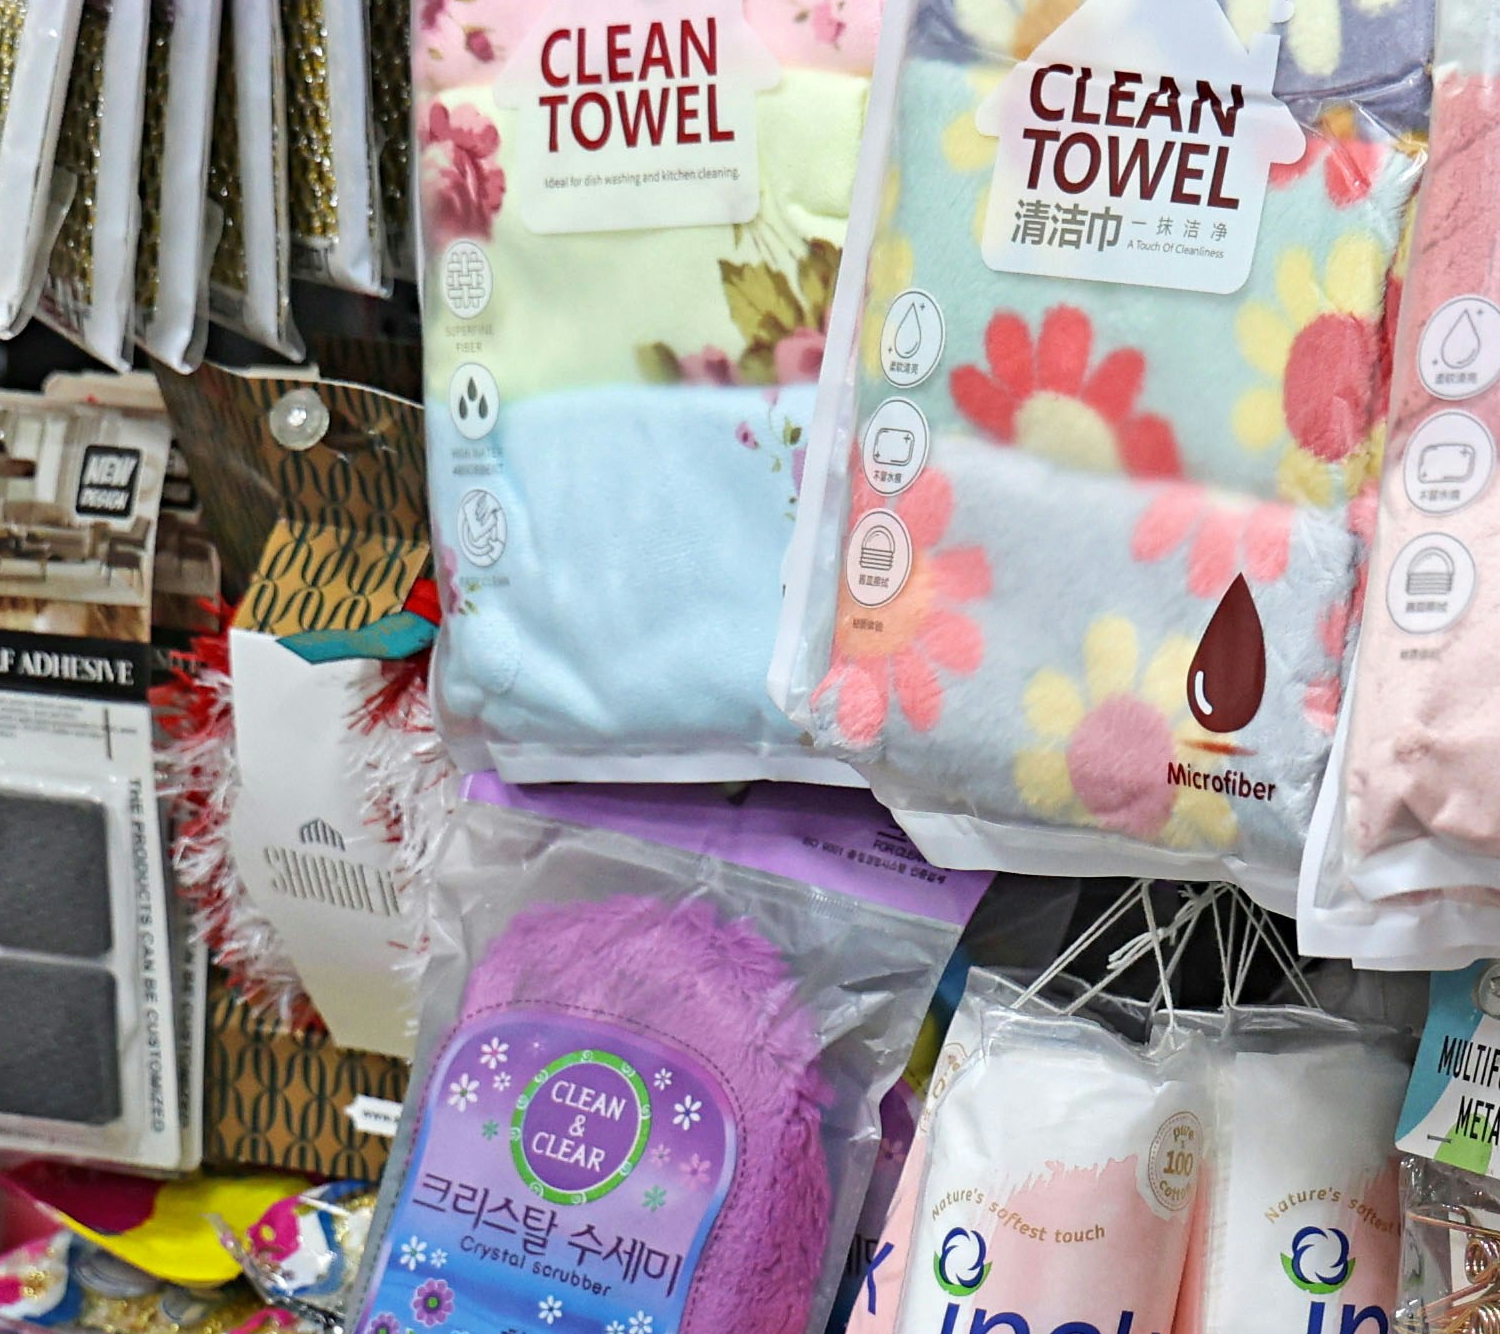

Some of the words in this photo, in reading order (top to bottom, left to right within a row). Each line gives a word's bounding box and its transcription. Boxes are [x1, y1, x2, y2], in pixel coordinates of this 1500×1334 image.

[540, 17, 718, 88] CLEAN
[539, 83, 736, 154] TOWEL
[1030, 63, 1245, 138] CLEAN
[1022, 128, 1240, 210] TOWEL
[1011, 199, 1124, 253] 清洁巾
[1136, 240, 1162, 254] Touch
[18, 651, 135, 686] ADHESIVE
[1167, 763, 1277, 803] Microfiber
[551, 1080, 627, 1122] CLEAN
[569, 1114, 587, 1137] &
[531, 1131, 606, 1173] CLEAR
[1163, 1149, 1194, 1177] 100
[931, 1187, 985, 1221] Nature's
[988, 1201, 1047, 1242] softest
[1054, 1223, 1106, 1244] touch
[1264, 1187, 1342, 1225] Nature's
[412, 1173, 559, 1257] 크리스탈
[567, 1224, 683, 1299] 수세미
[459, 1235, 526, 1270] Crystal
[531, 1261, 612, 1297] scrubber
